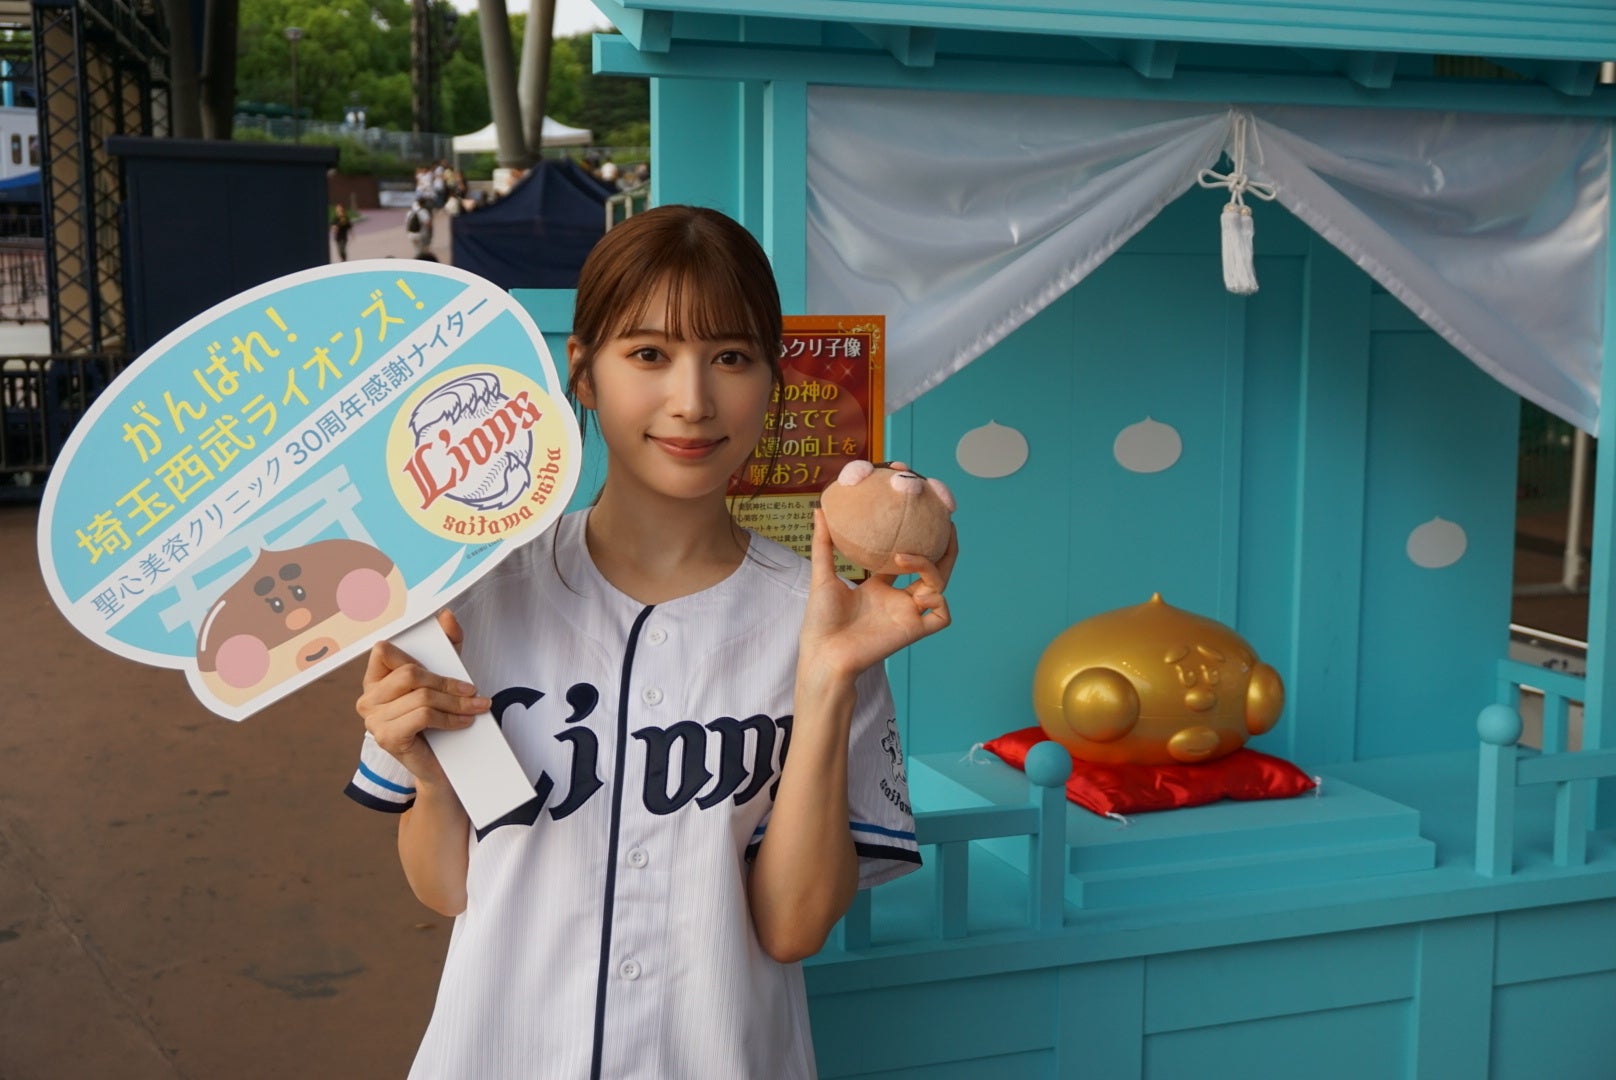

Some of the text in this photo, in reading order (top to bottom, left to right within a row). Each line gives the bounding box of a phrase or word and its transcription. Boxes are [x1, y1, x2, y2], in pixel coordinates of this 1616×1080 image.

[75, 278, 425, 565] 埼玉西武ライオンズ！
[90, 298, 488, 621] 聖心美容クリニック 30周年感謝ナイター
[122, 306, 299, 463] がんばれ！
[403, 391, 543, 510] Lions
[754, 436, 857, 459] 運の向上を
